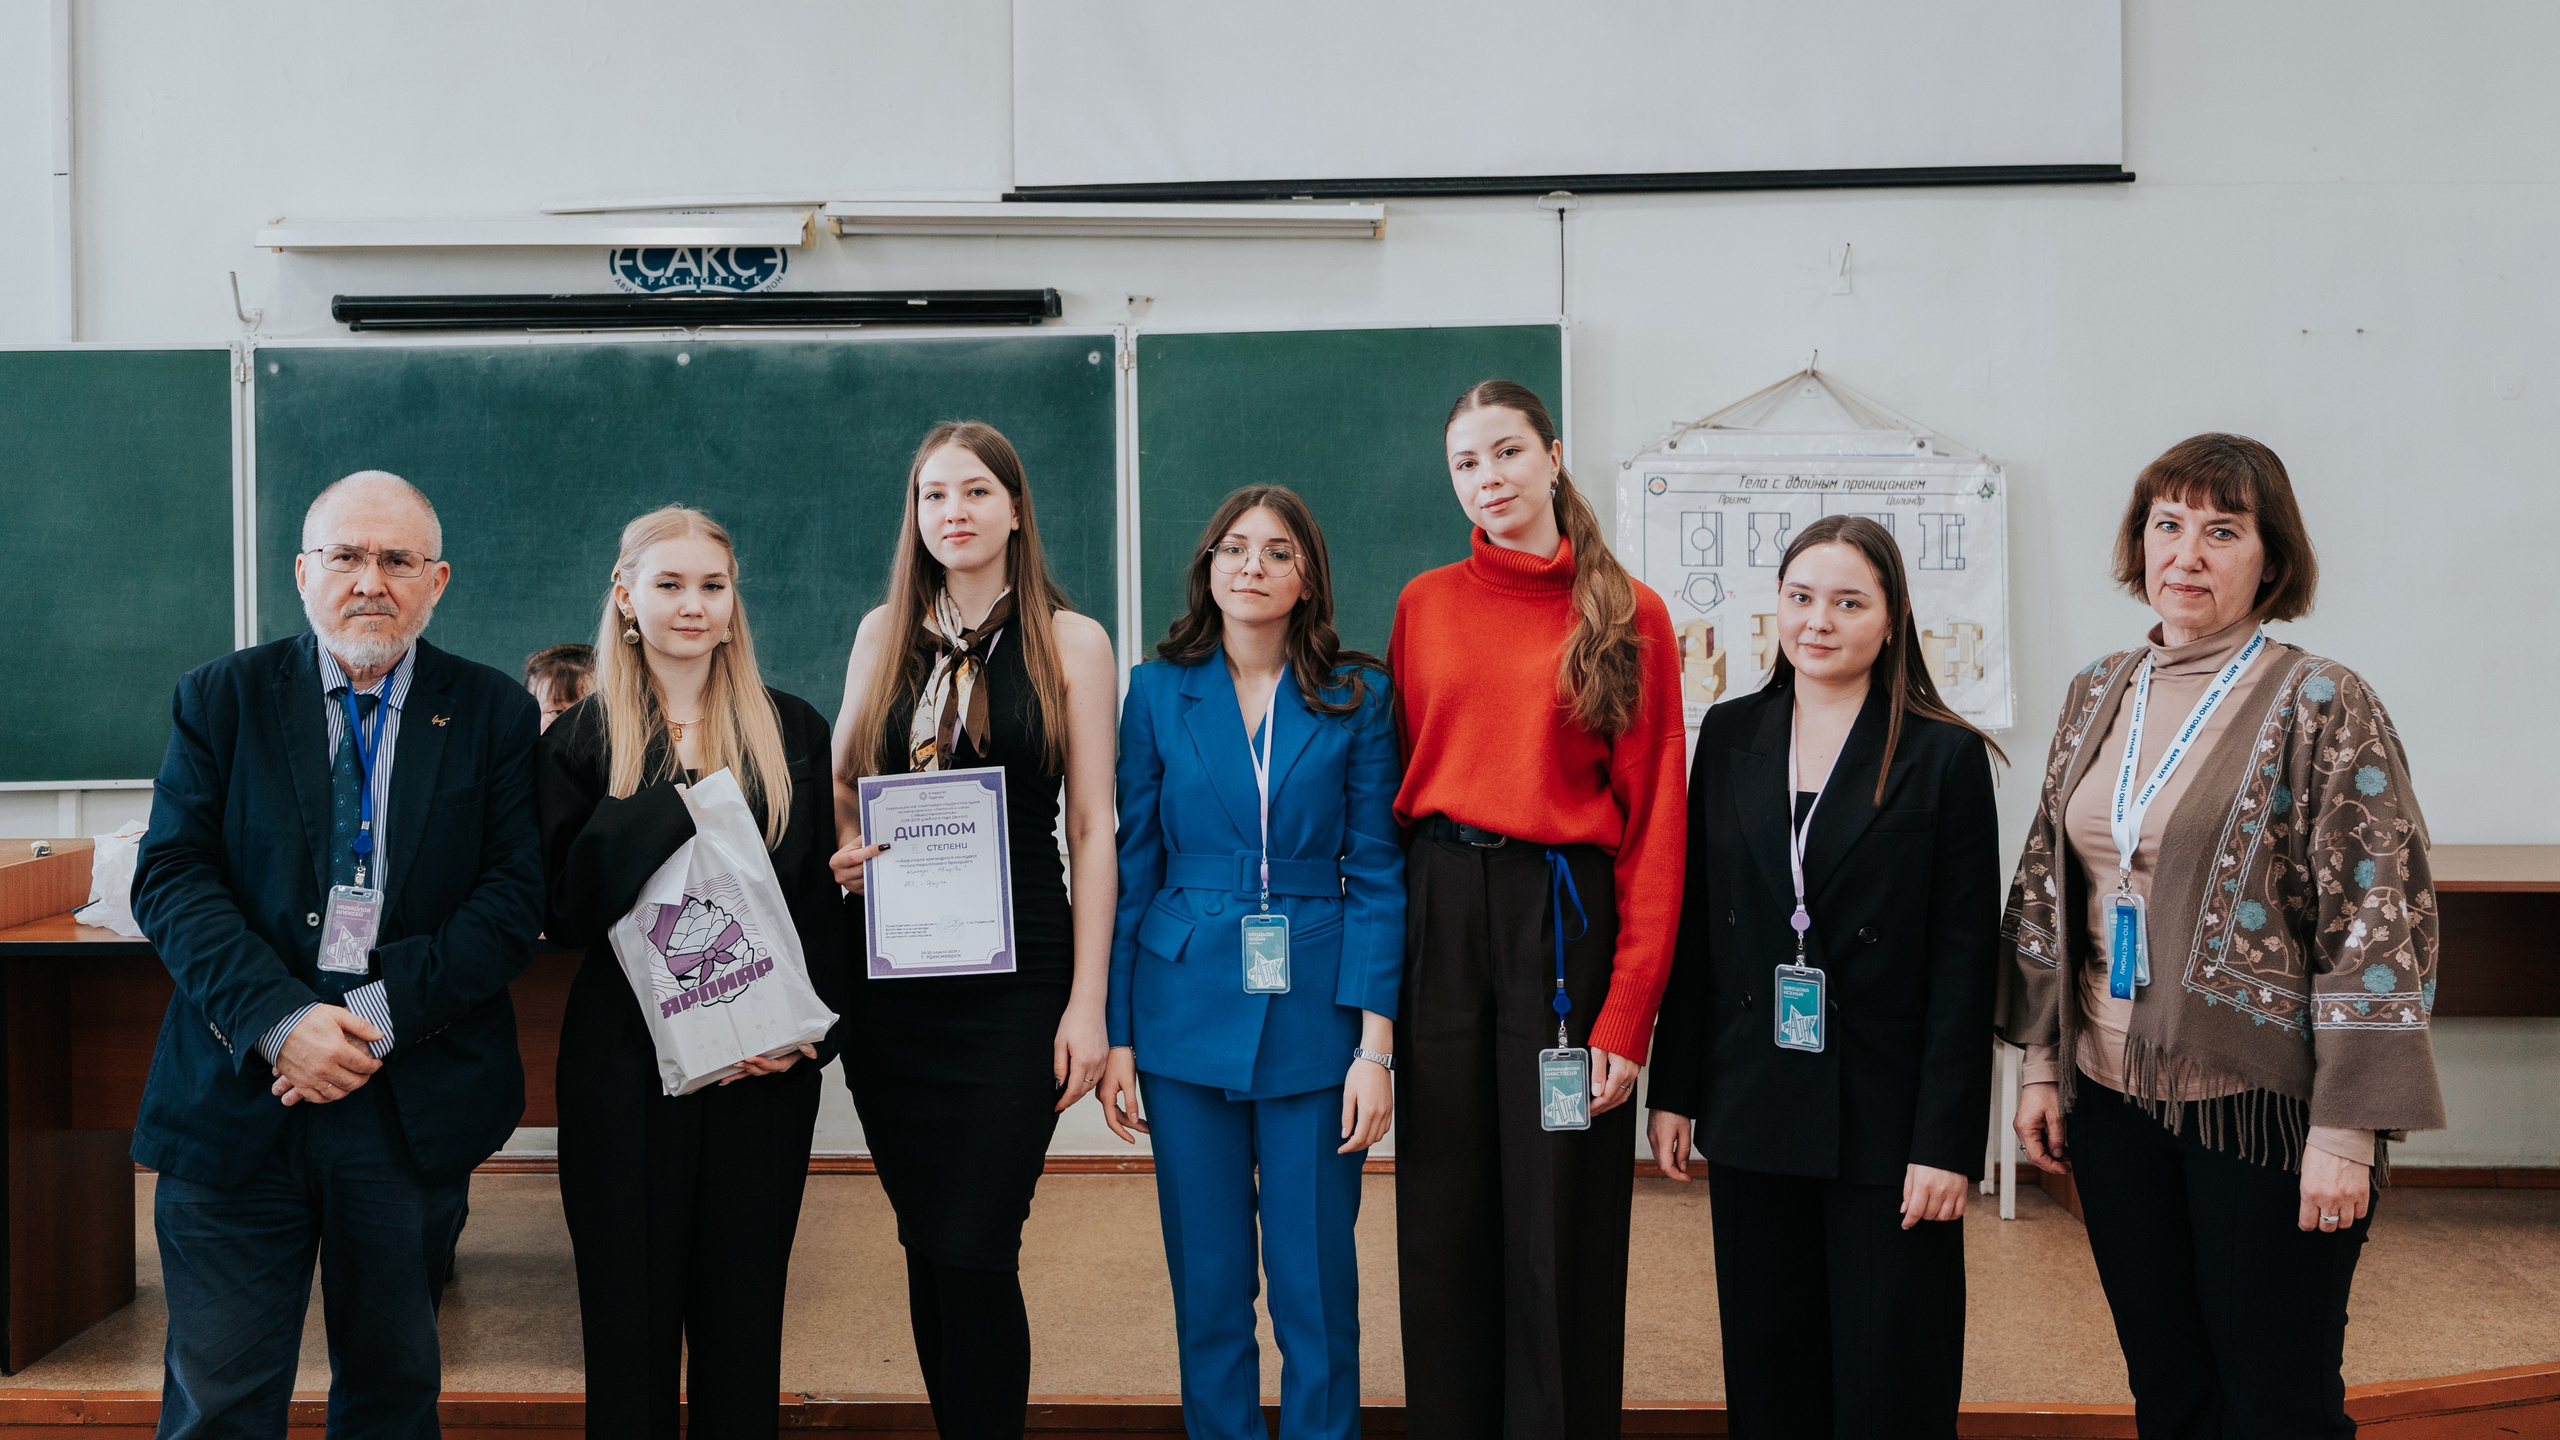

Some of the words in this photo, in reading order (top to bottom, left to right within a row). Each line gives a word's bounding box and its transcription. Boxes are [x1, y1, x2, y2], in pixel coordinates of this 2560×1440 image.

[634, 275, 762, 286] КРАСНОЯРСК
[1738, 475, 1767, 489] Тела
[1772, 479, 1780, 489] с
[1785, 475, 1838, 489] двойным
[1842, 479, 1926, 492] проницанием
[1717, 494, 1752, 506] Призма
[1885, 495, 1925, 506] Цилиндр
[2199, 689, 2221, 716] ЧЕСТНО
[2181, 715, 2202, 743] ГОВОРЯ
[2157, 748, 2180, 779] БАРНАУЛ
[2120, 765, 2131, 791] ГОВОРЯ
[2116, 792, 2125, 823] ЧЕСТНО
[894, 822, 976, 841] ДИПЛОМ
[926, 842, 968, 852] СТЕПЕНИ
[335, 909, 364, 917] АЛЕКСЕЙ
[336, 904, 371, 913] МИХАЙЛОВ
[2119, 925, 2129, 976] ПО-ЧЕСТНОМУ
[660, 956, 774, 1019] ЯРПИАР
